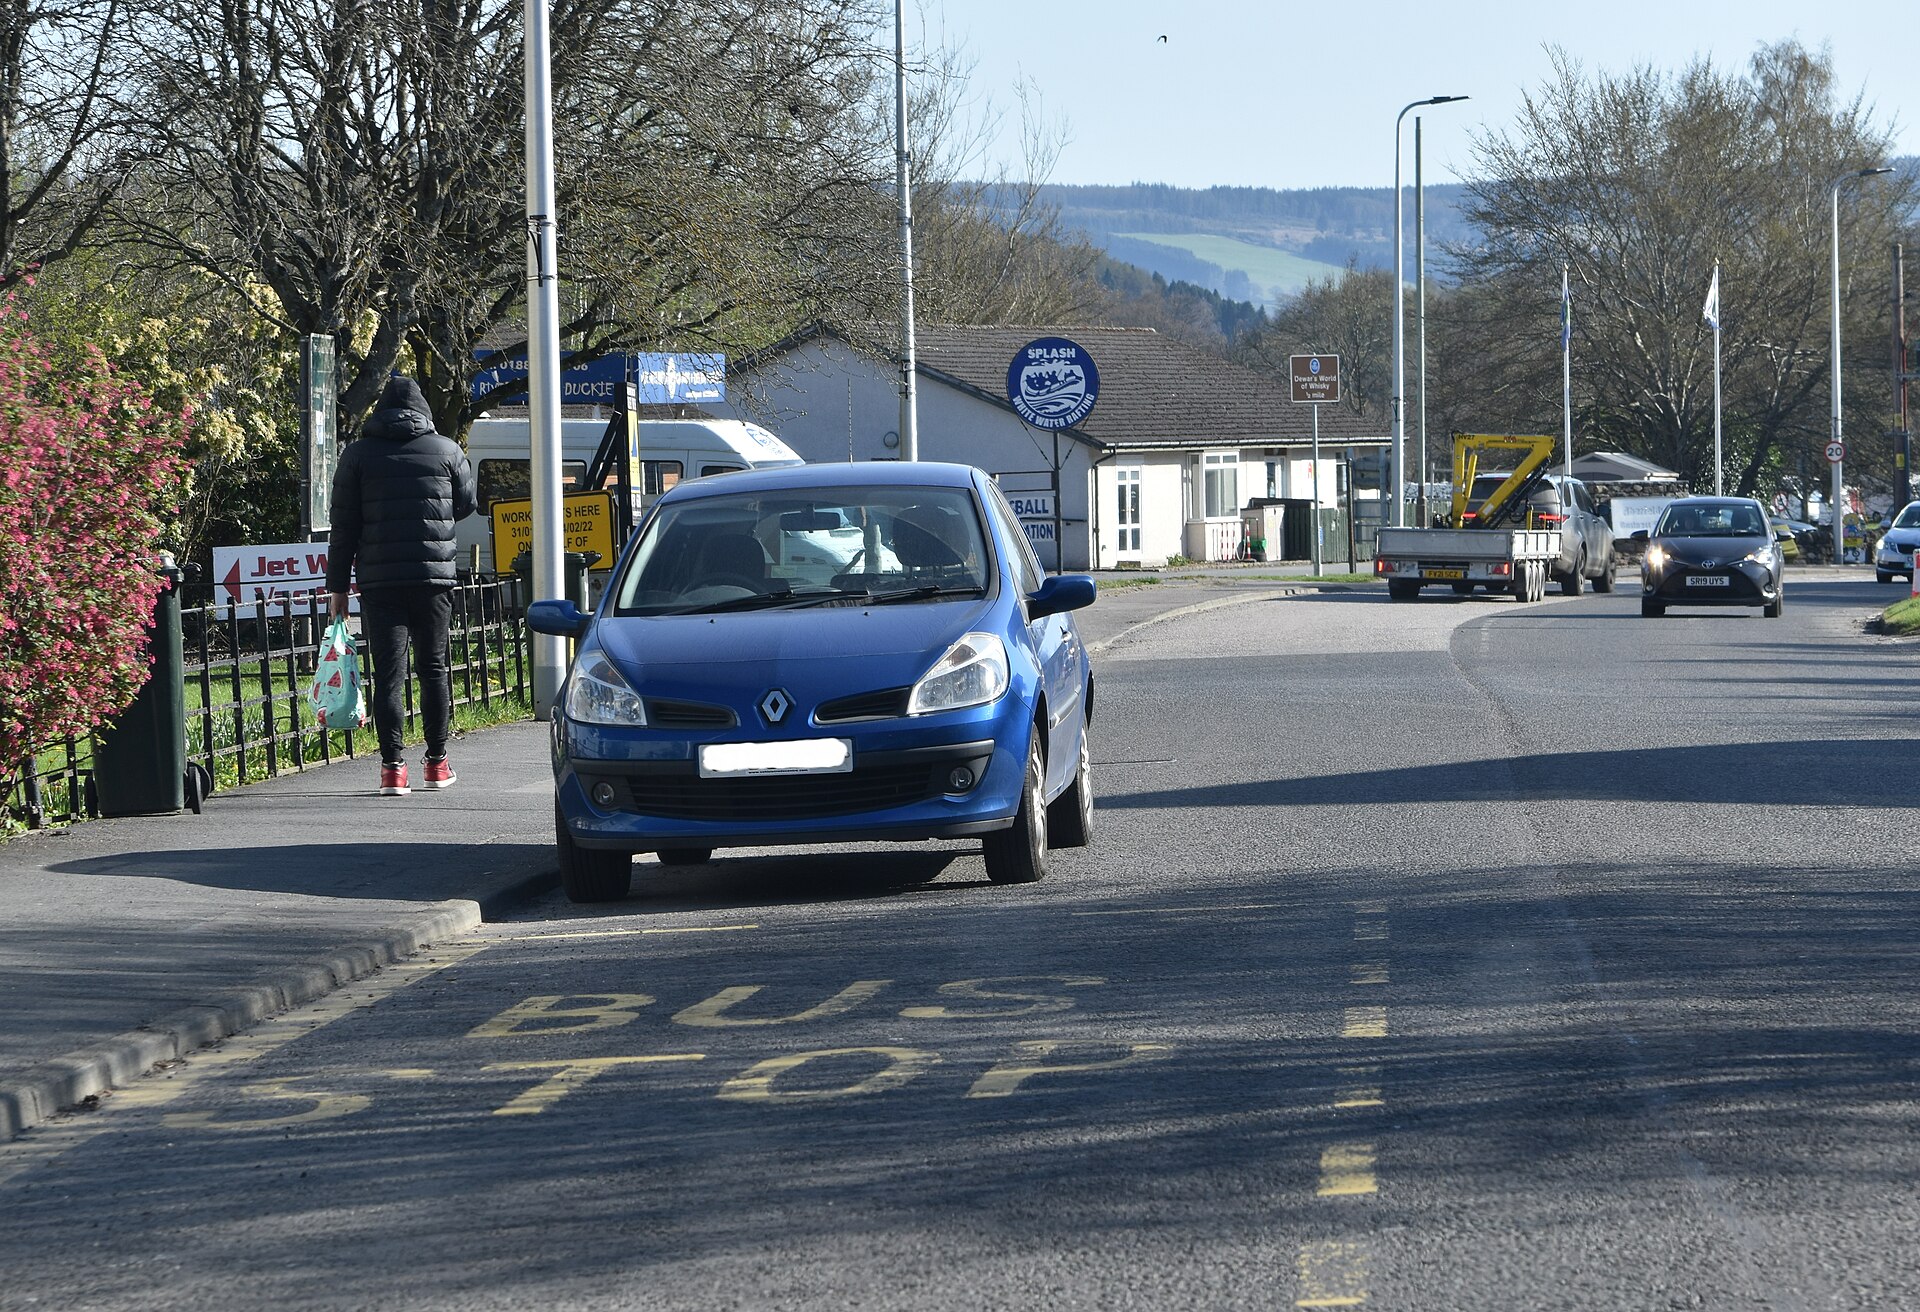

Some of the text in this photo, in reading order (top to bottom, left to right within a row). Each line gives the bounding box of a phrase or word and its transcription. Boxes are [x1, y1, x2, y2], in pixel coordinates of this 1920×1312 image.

[1027, 347, 1076, 359] SPLASH
[564, 381, 615, 396] DUCKIE
[1012, 393, 1095, 428] WHITE WATER RAFTING
[1827, 447, 1843, 457] 20
[574, 504, 601, 517] HERE
[511, 526, 533, 538] 31/0
[575, 536, 588, 547] OF
[250, 556, 301, 577] Jet
[1690, 577, 1725, 585] SR19 UYS
[464, 975, 1108, 1039] BUS
[160, 1039, 1178, 1131] STOP
